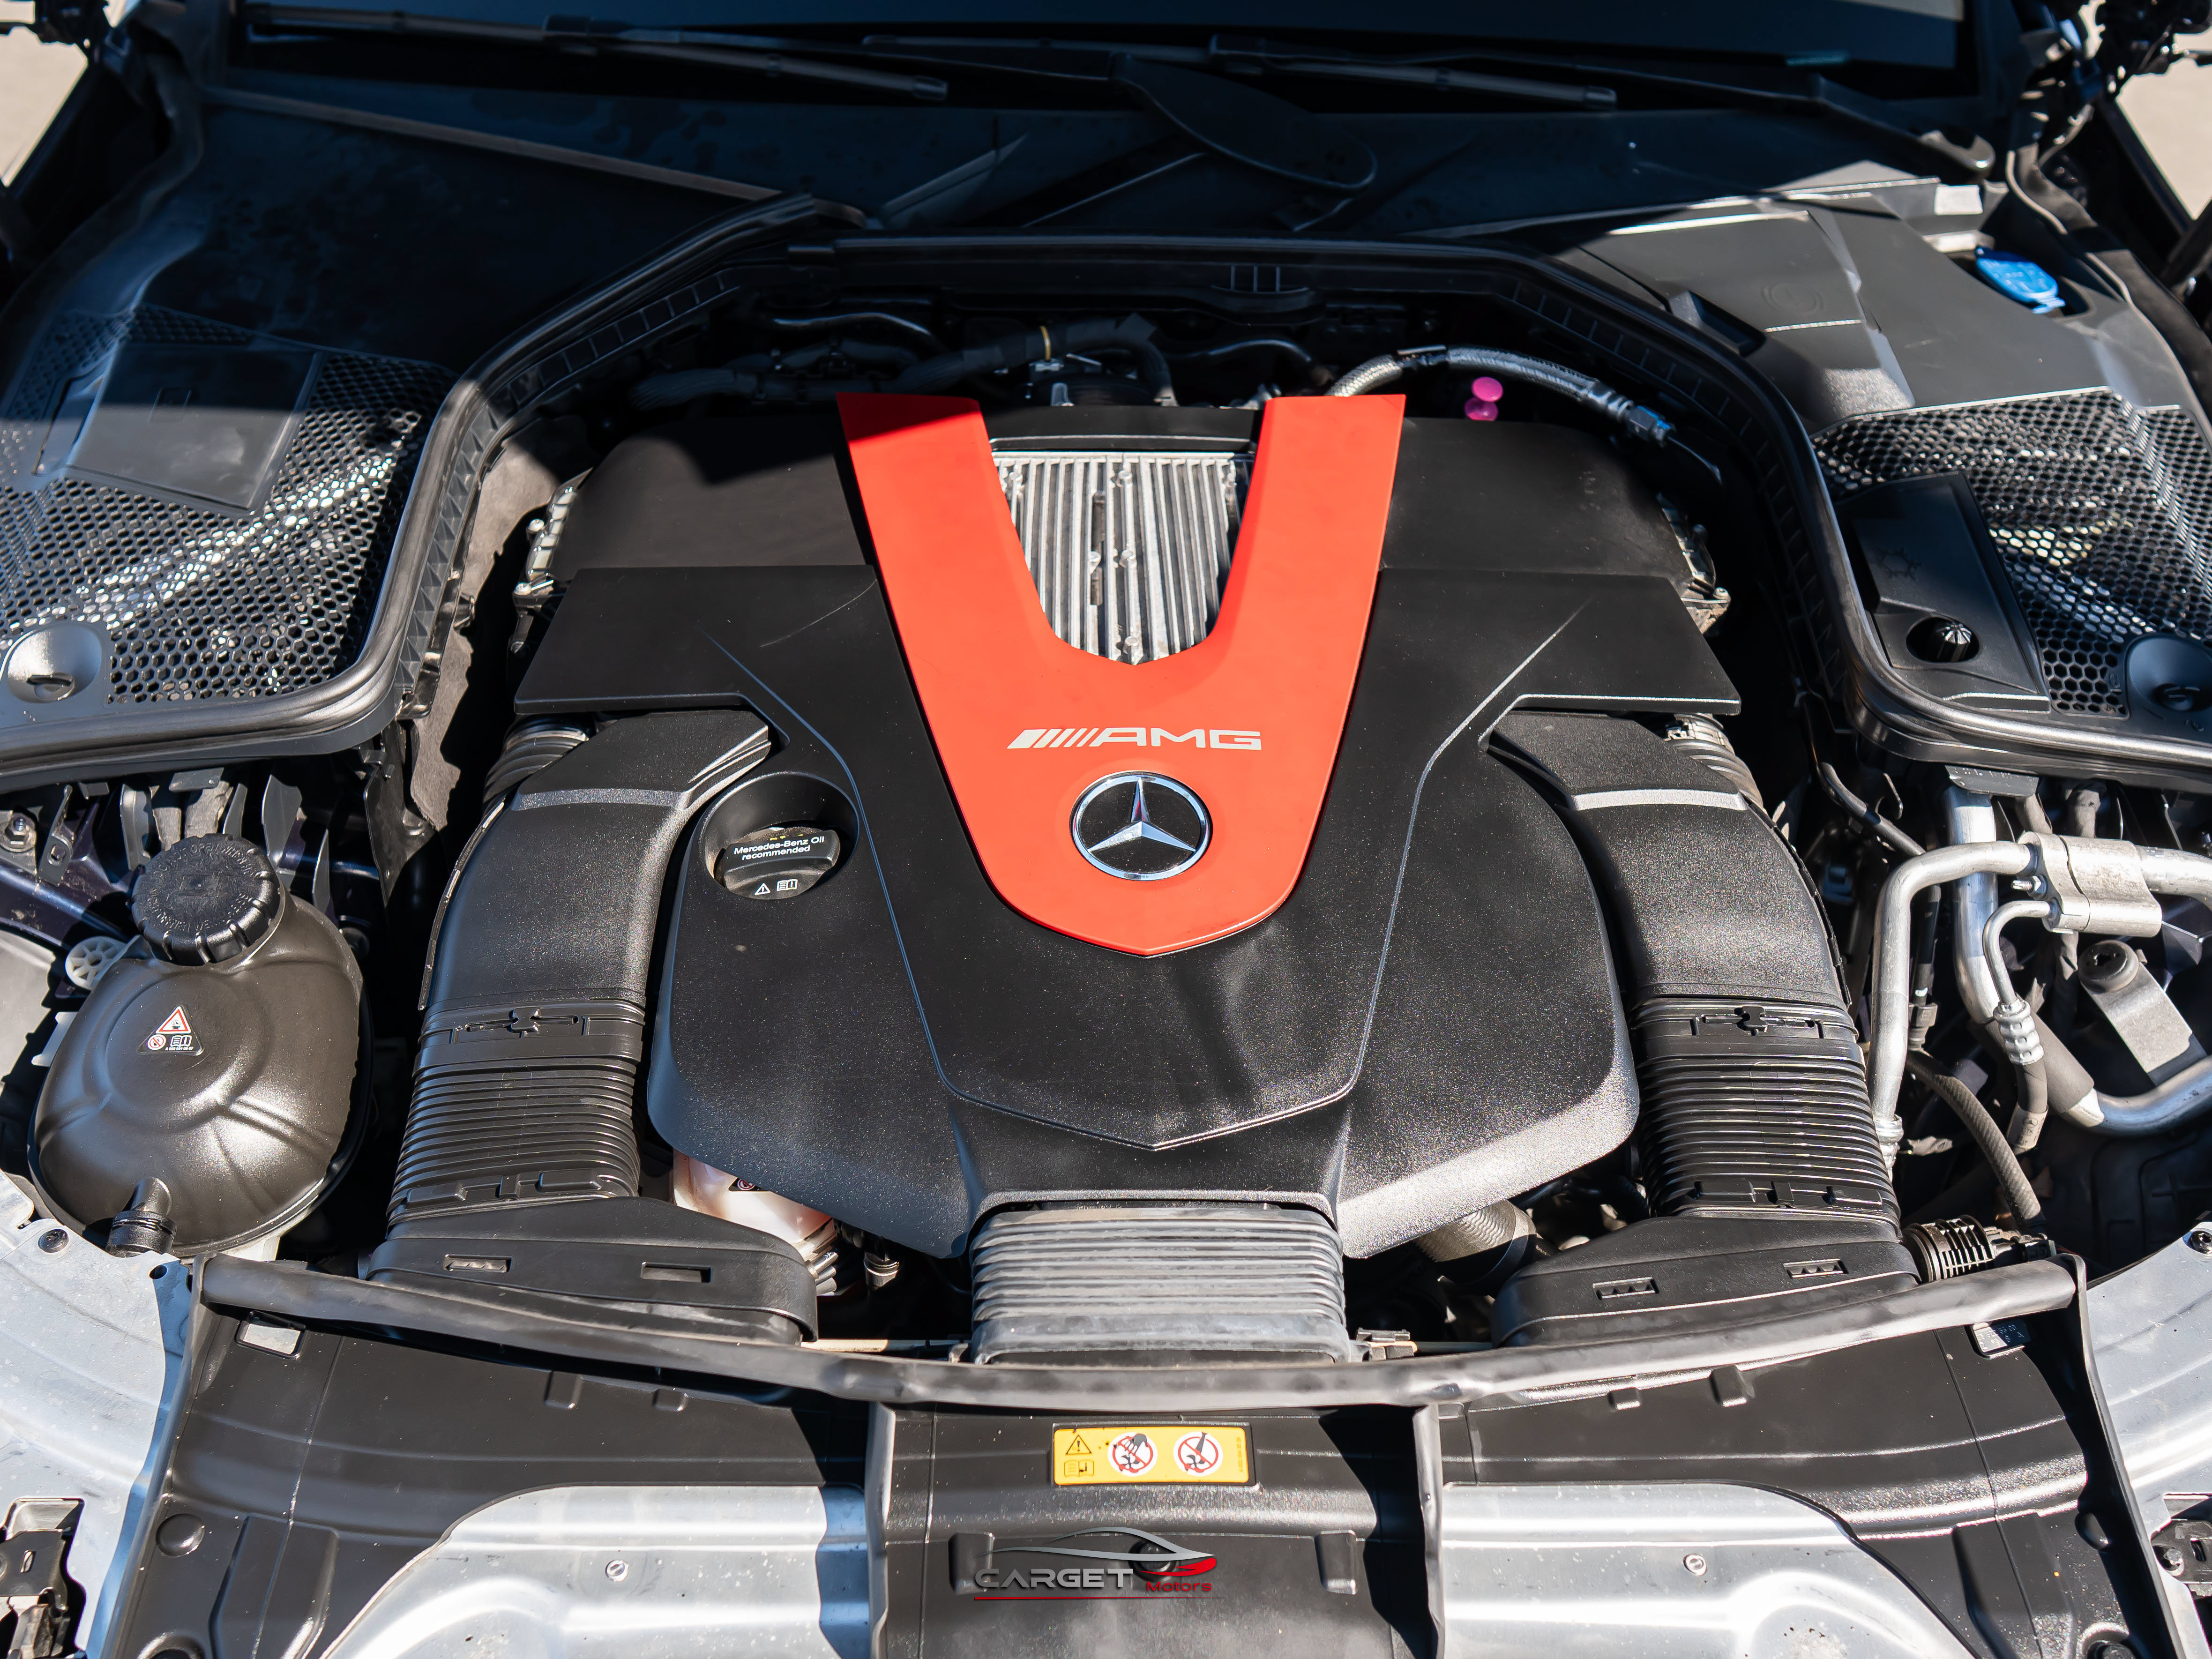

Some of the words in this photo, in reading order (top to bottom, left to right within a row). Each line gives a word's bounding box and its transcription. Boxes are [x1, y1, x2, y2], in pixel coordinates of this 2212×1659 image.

[1088, 727, 1262, 750] AMG
[733, 839, 809, 855] Mercedes-Benz
[742, 845, 811, 860] recommended
